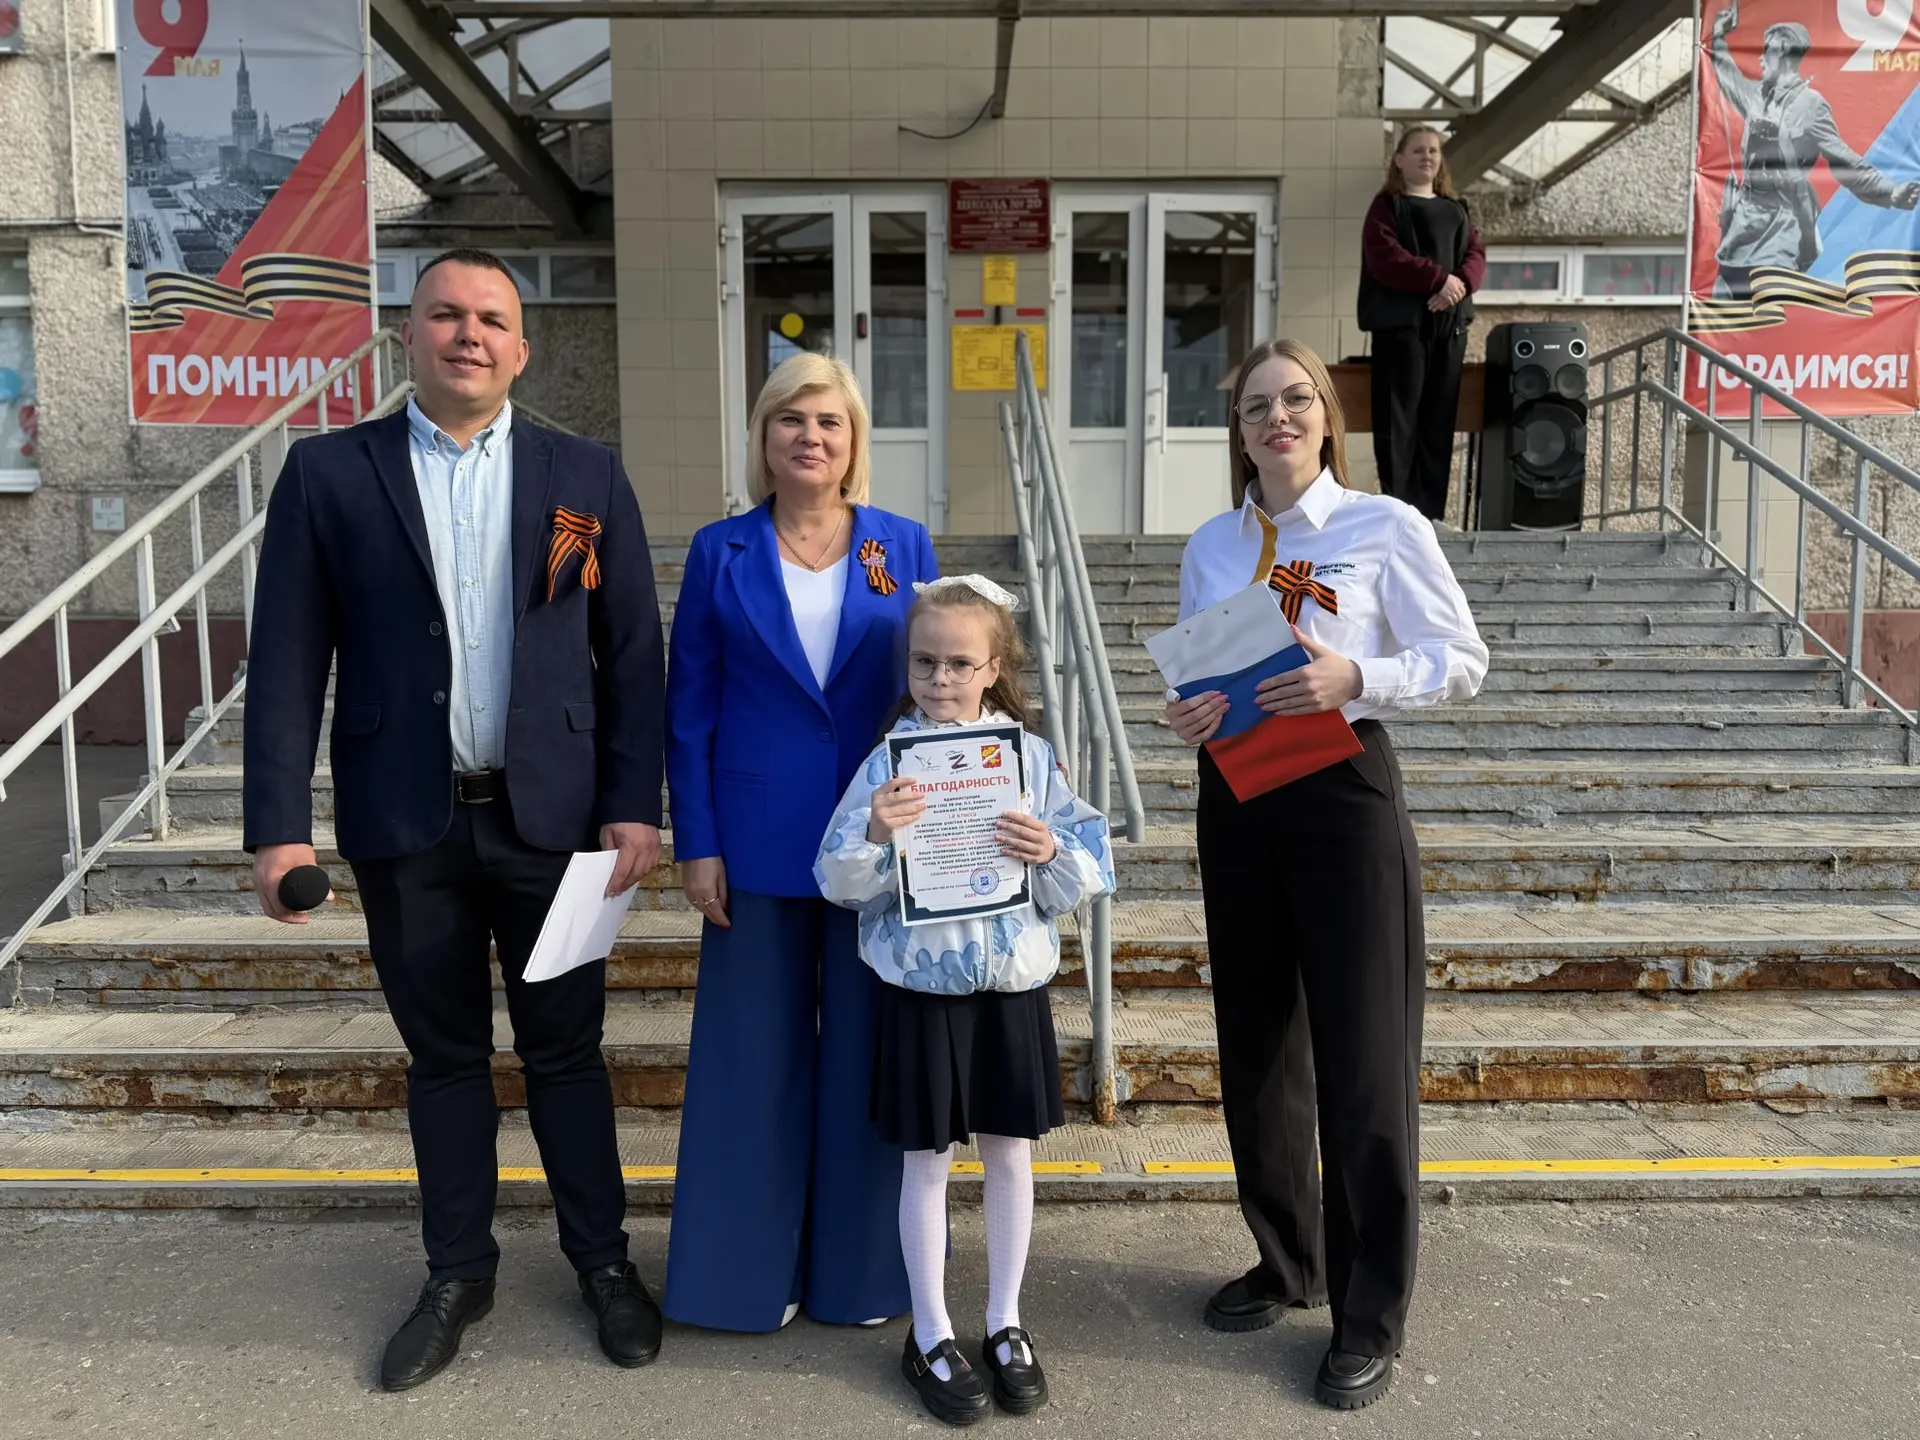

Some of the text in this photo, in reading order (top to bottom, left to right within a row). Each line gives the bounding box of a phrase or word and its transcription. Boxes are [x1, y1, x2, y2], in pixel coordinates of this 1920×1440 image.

[173, 56, 220, 77] МАЯ
[1873, 49, 1920, 72] МАЯ
[910, 776, 1010, 793] БЛАГОДАРНОСТЬ
